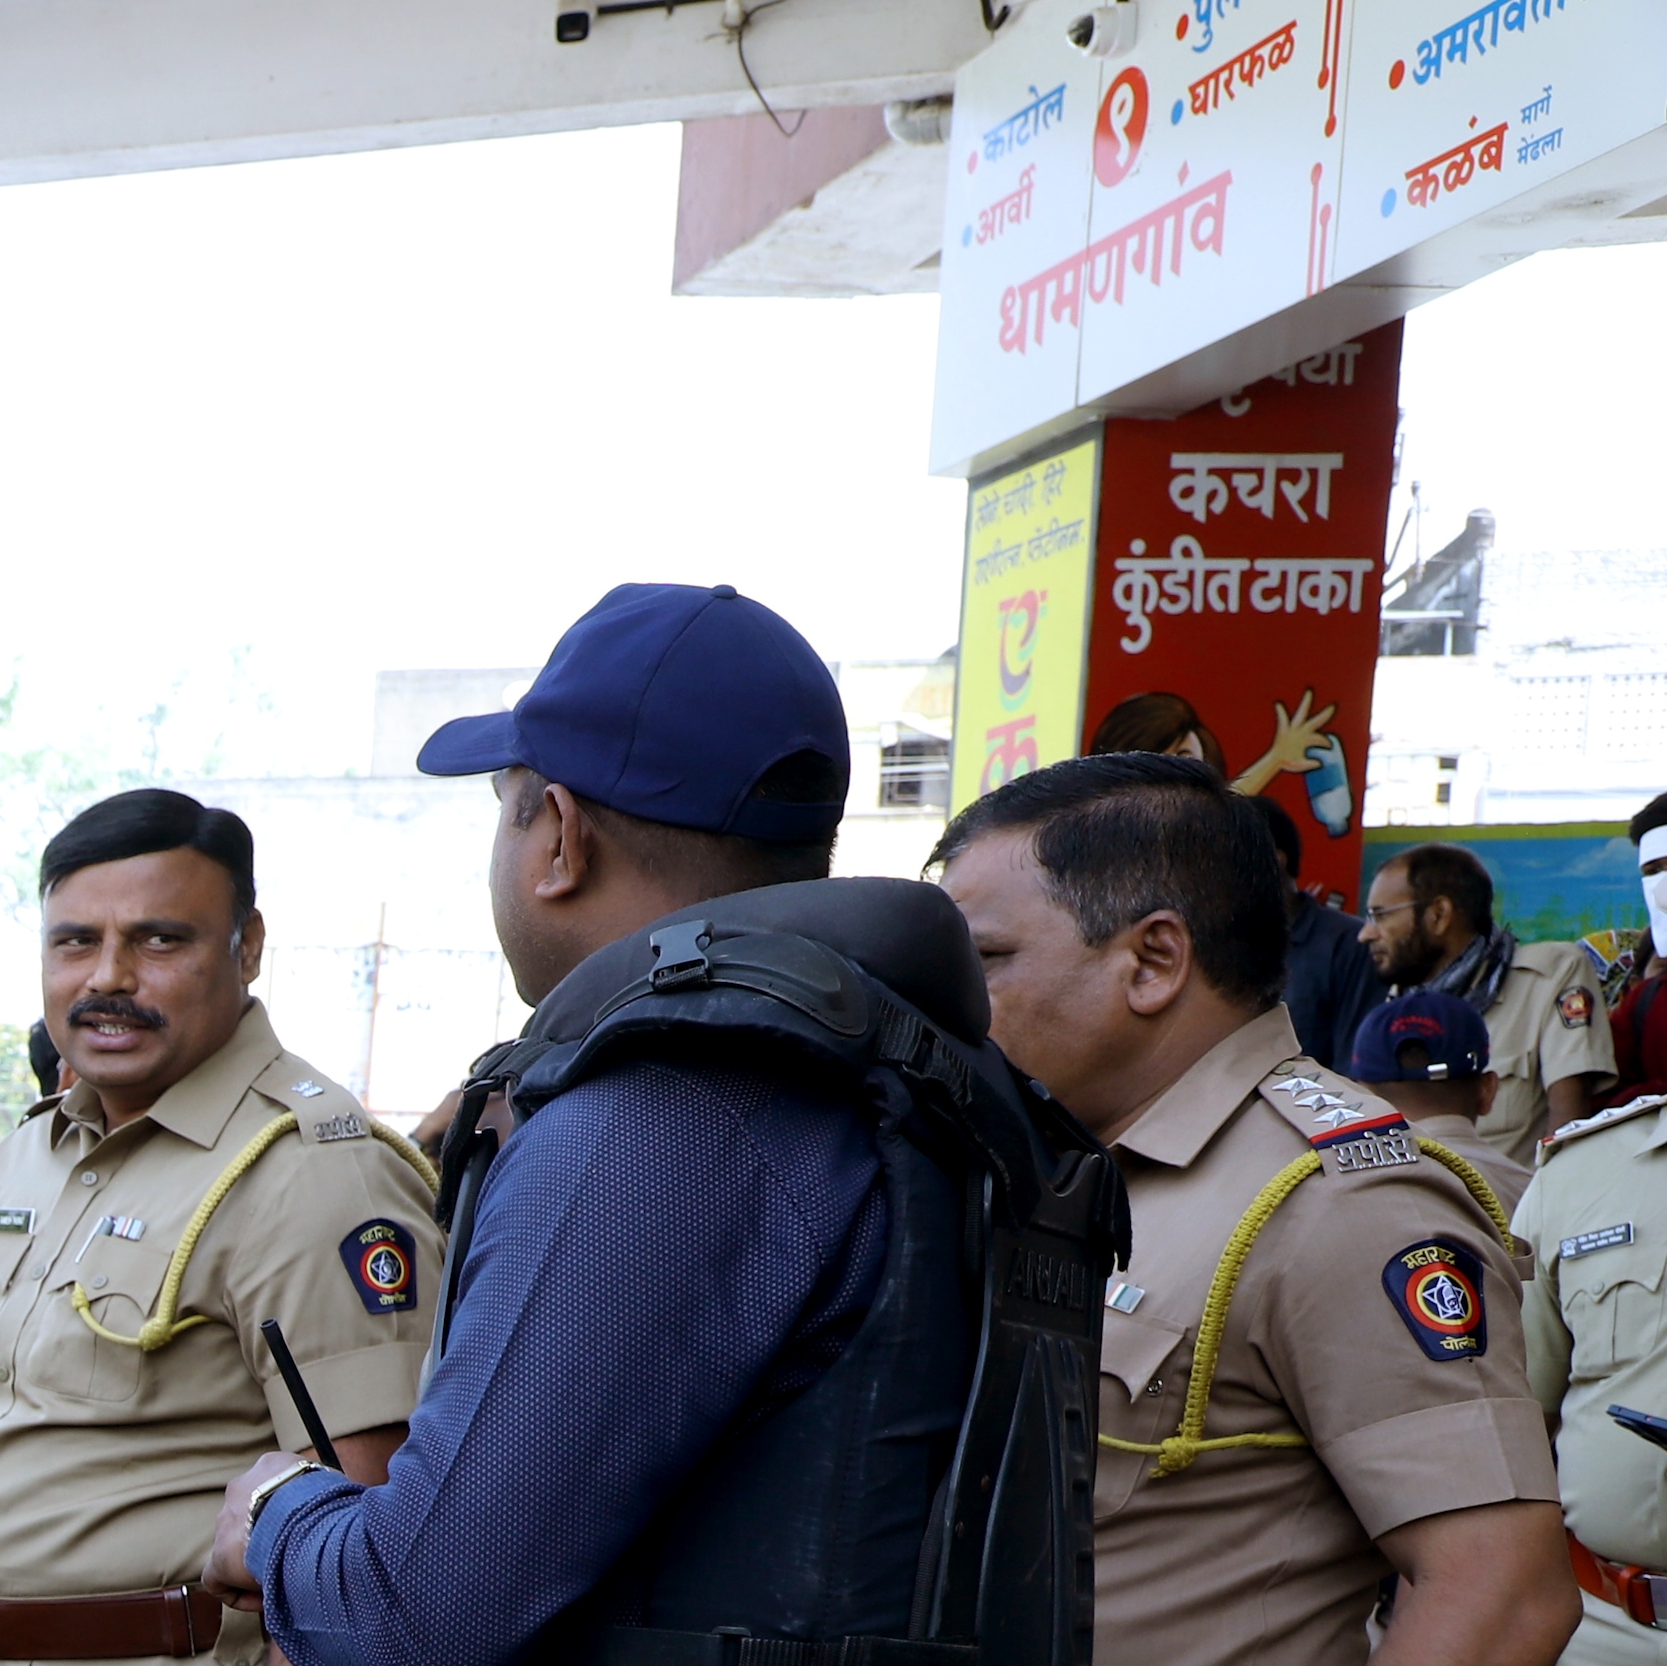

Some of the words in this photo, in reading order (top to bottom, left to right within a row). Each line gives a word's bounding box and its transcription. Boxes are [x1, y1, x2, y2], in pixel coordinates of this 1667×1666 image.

[1188, 20, 1297, 116] घारफळ
[983, 83, 1067, 162] काटोल
[1405, 115, 1509, 208] कळंब
[975, 163, 1036, 245] आर्वी
[999, 161, 1234, 354] धामणगांव
[1169, 453, 1344, 523] कचरा
[1113, 534, 1251, 654] कुंडीत
[1250, 558, 1375, 615] टाका
[1332, 1128, 1417, 1171] मपोसे
